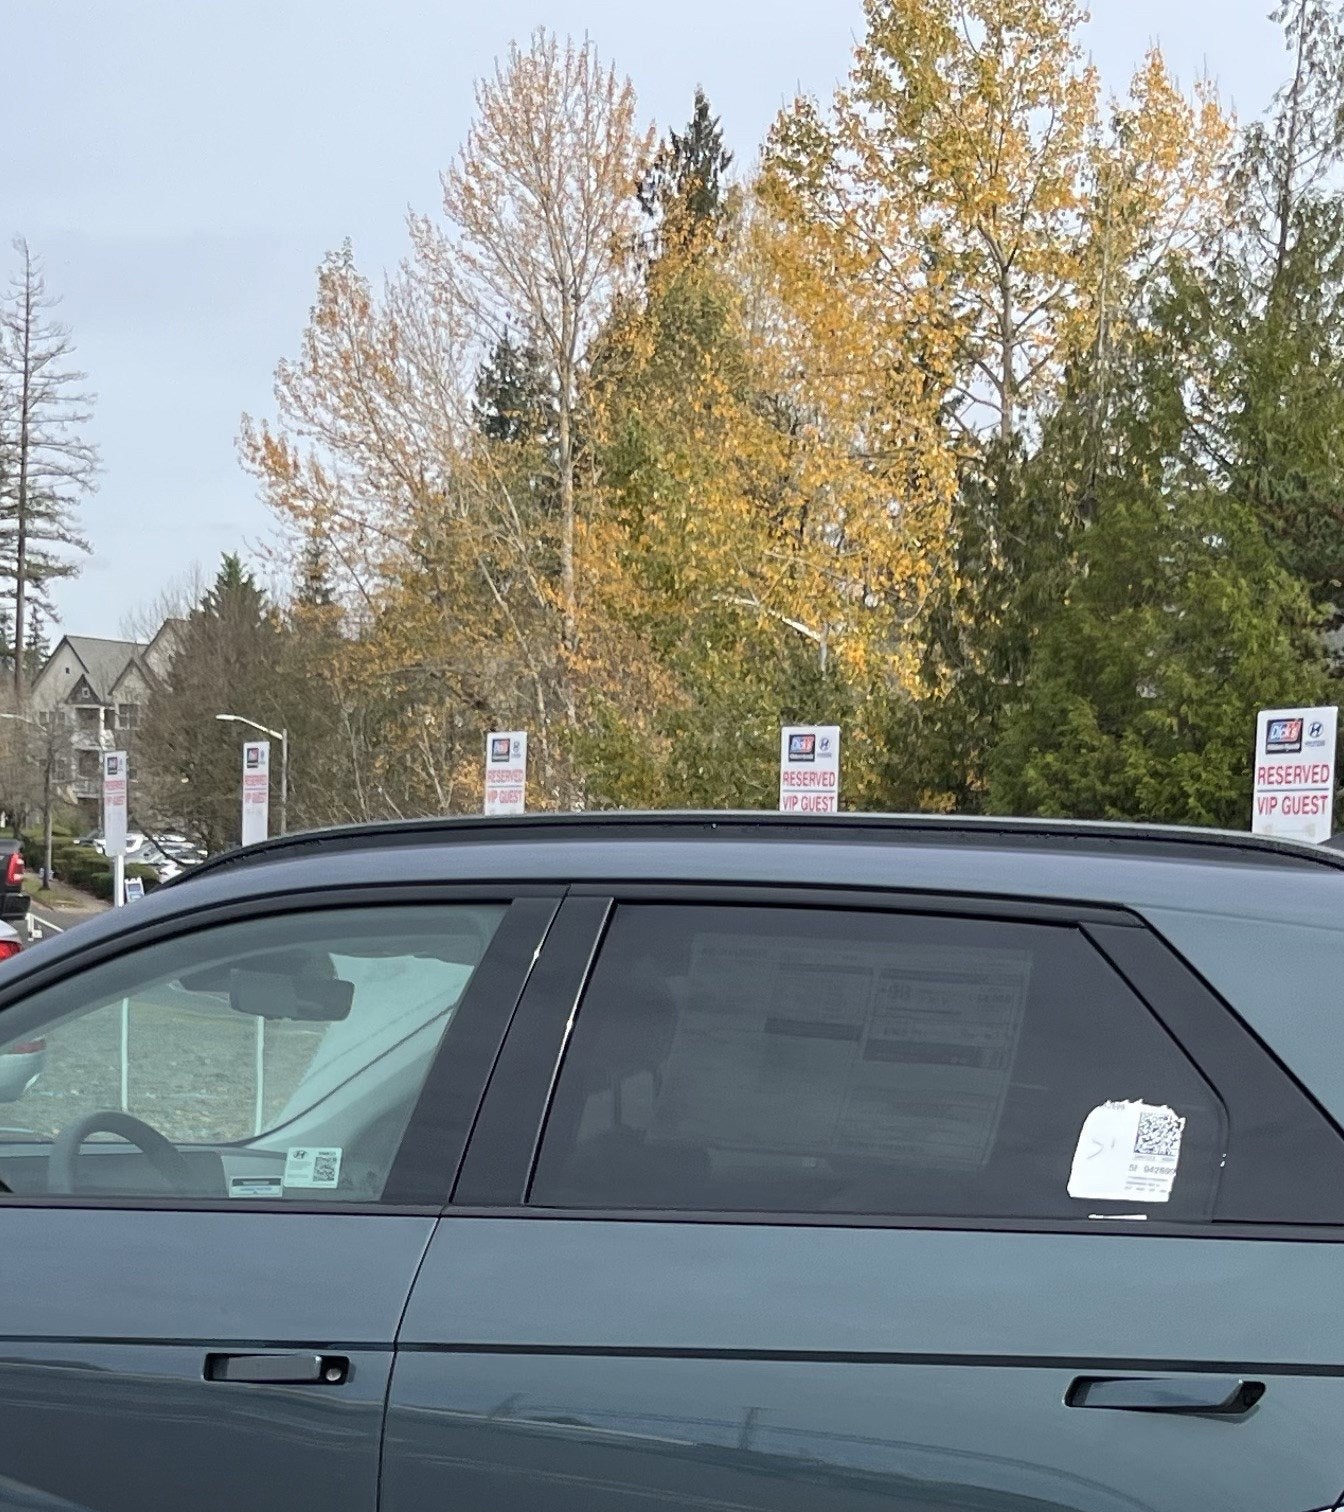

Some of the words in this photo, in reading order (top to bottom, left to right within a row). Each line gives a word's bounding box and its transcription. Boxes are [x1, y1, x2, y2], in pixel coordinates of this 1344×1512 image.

[782, 771, 836, 787] RESERVED
[1258, 764, 1330, 785] RESERVED
[783, 796, 799, 811] VIP
[801, 796, 835, 812] GUEST
[1257, 797, 1278, 815] VIP
[1282, 795, 1328, 815] GUEST
